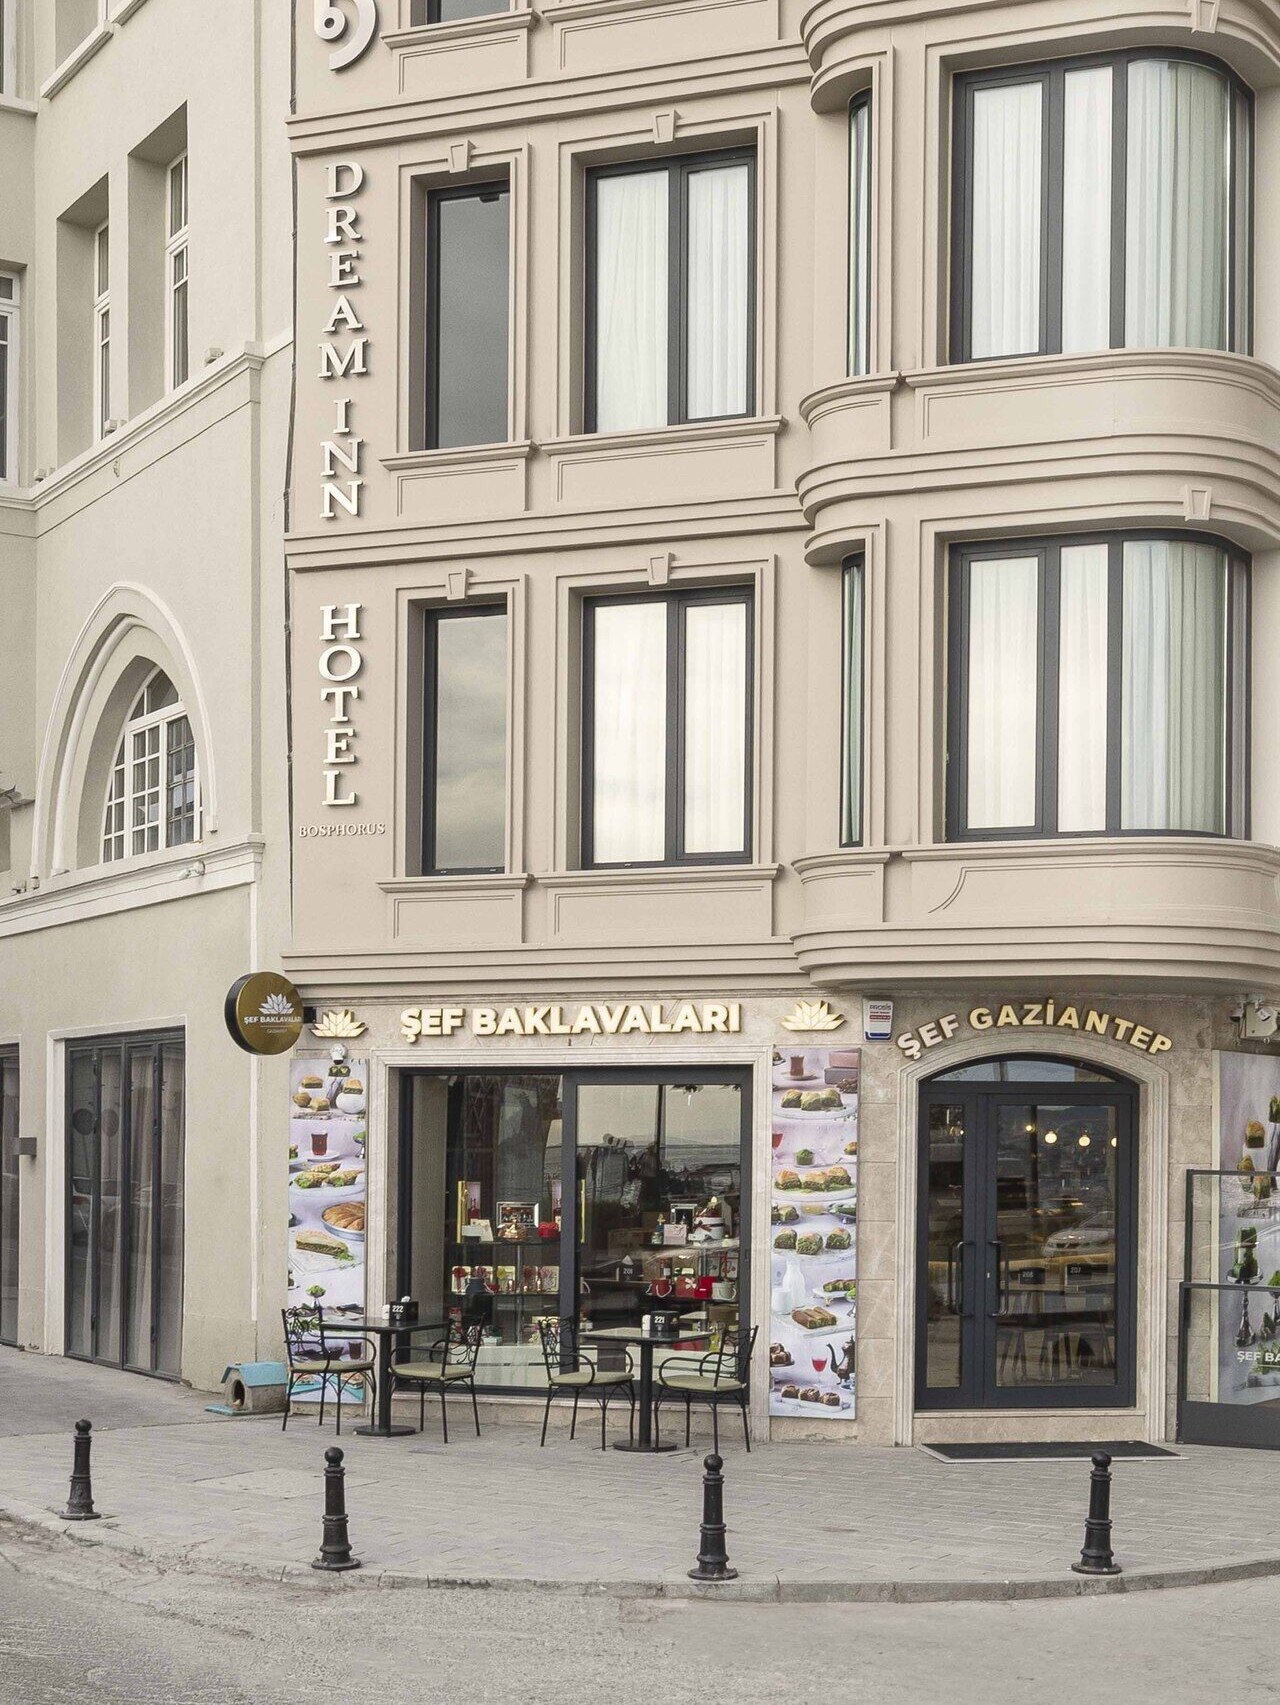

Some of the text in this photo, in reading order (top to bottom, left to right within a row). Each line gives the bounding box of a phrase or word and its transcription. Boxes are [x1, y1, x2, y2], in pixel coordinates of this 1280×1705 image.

[318, 161, 369, 518] DREAM INN
[318, 603, 363, 806] HOTEL
[299, 822, 386, 838] BOSPHORUS
[243, 1016, 259, 1025] ŞEF
[400, 1002, 741, 1044] ŞEF BAKLAVALARI
[897, 999, 1173, 1060] ŞEF GAZİANTEP
[391, 1305, 404, 1313] 222
[654, 1316, 665, 1324] 221
[1237, 1350, 1261, 1363] ŞEF
